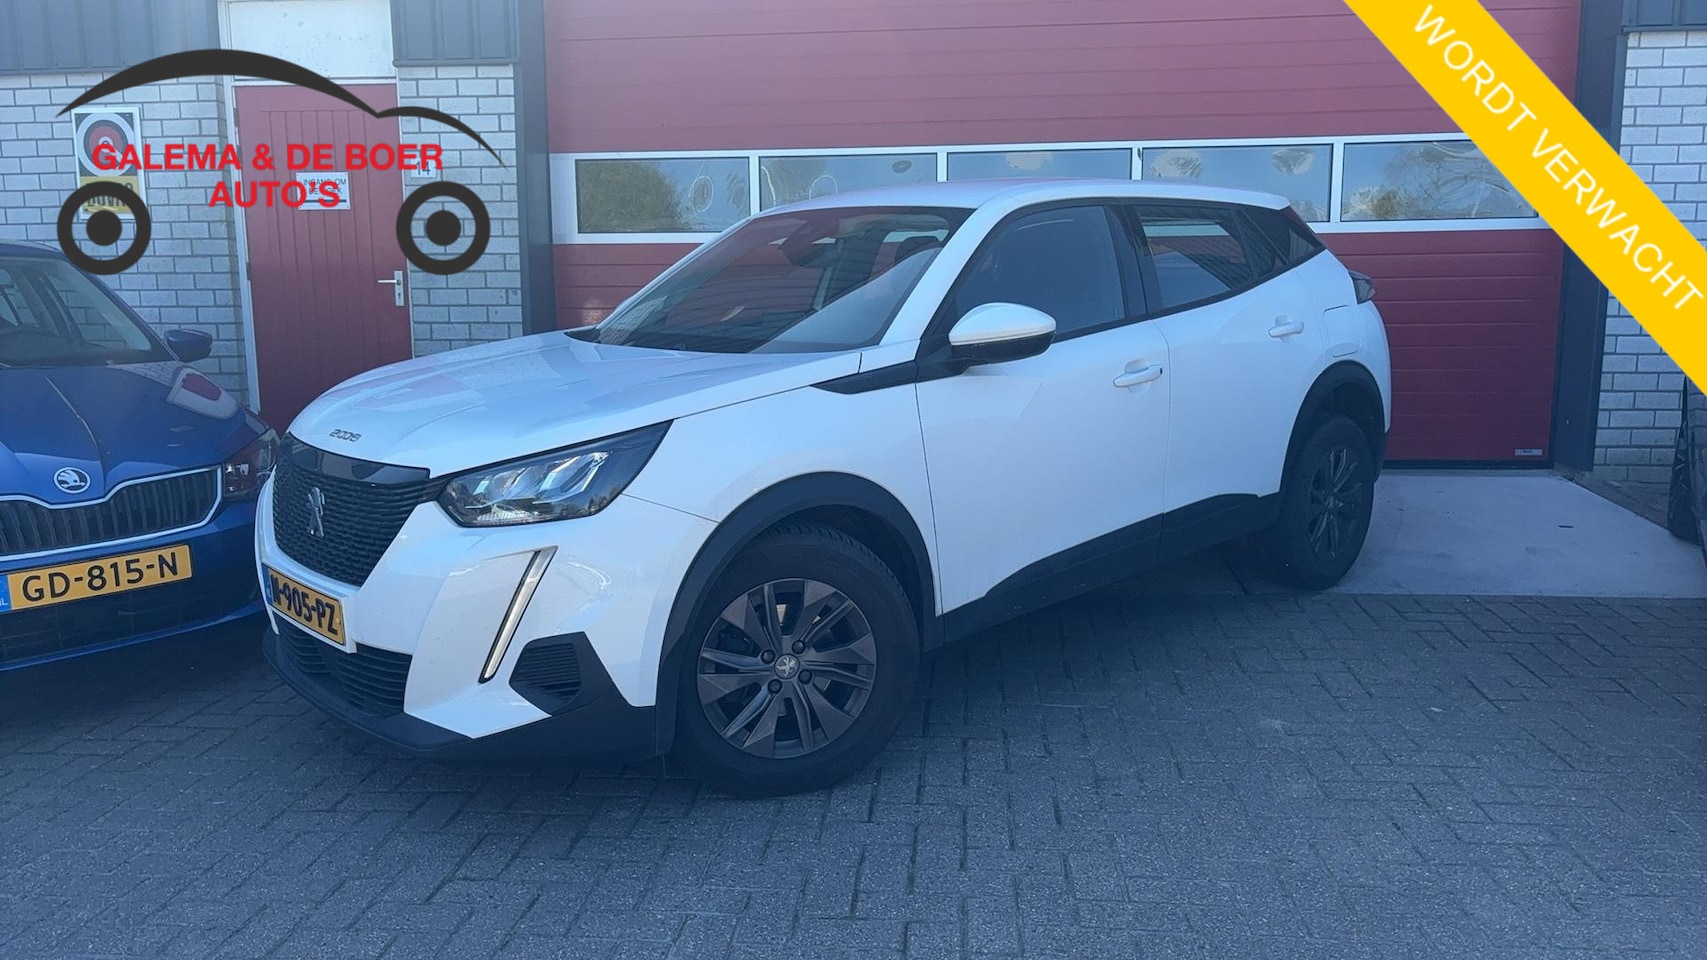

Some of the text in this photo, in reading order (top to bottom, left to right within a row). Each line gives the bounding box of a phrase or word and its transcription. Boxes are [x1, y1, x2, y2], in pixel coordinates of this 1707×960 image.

[416, 161, 431, 176] 14
[329, 428, 362, 443] 2008
[22, 552, 178, 602] GD-815-N
